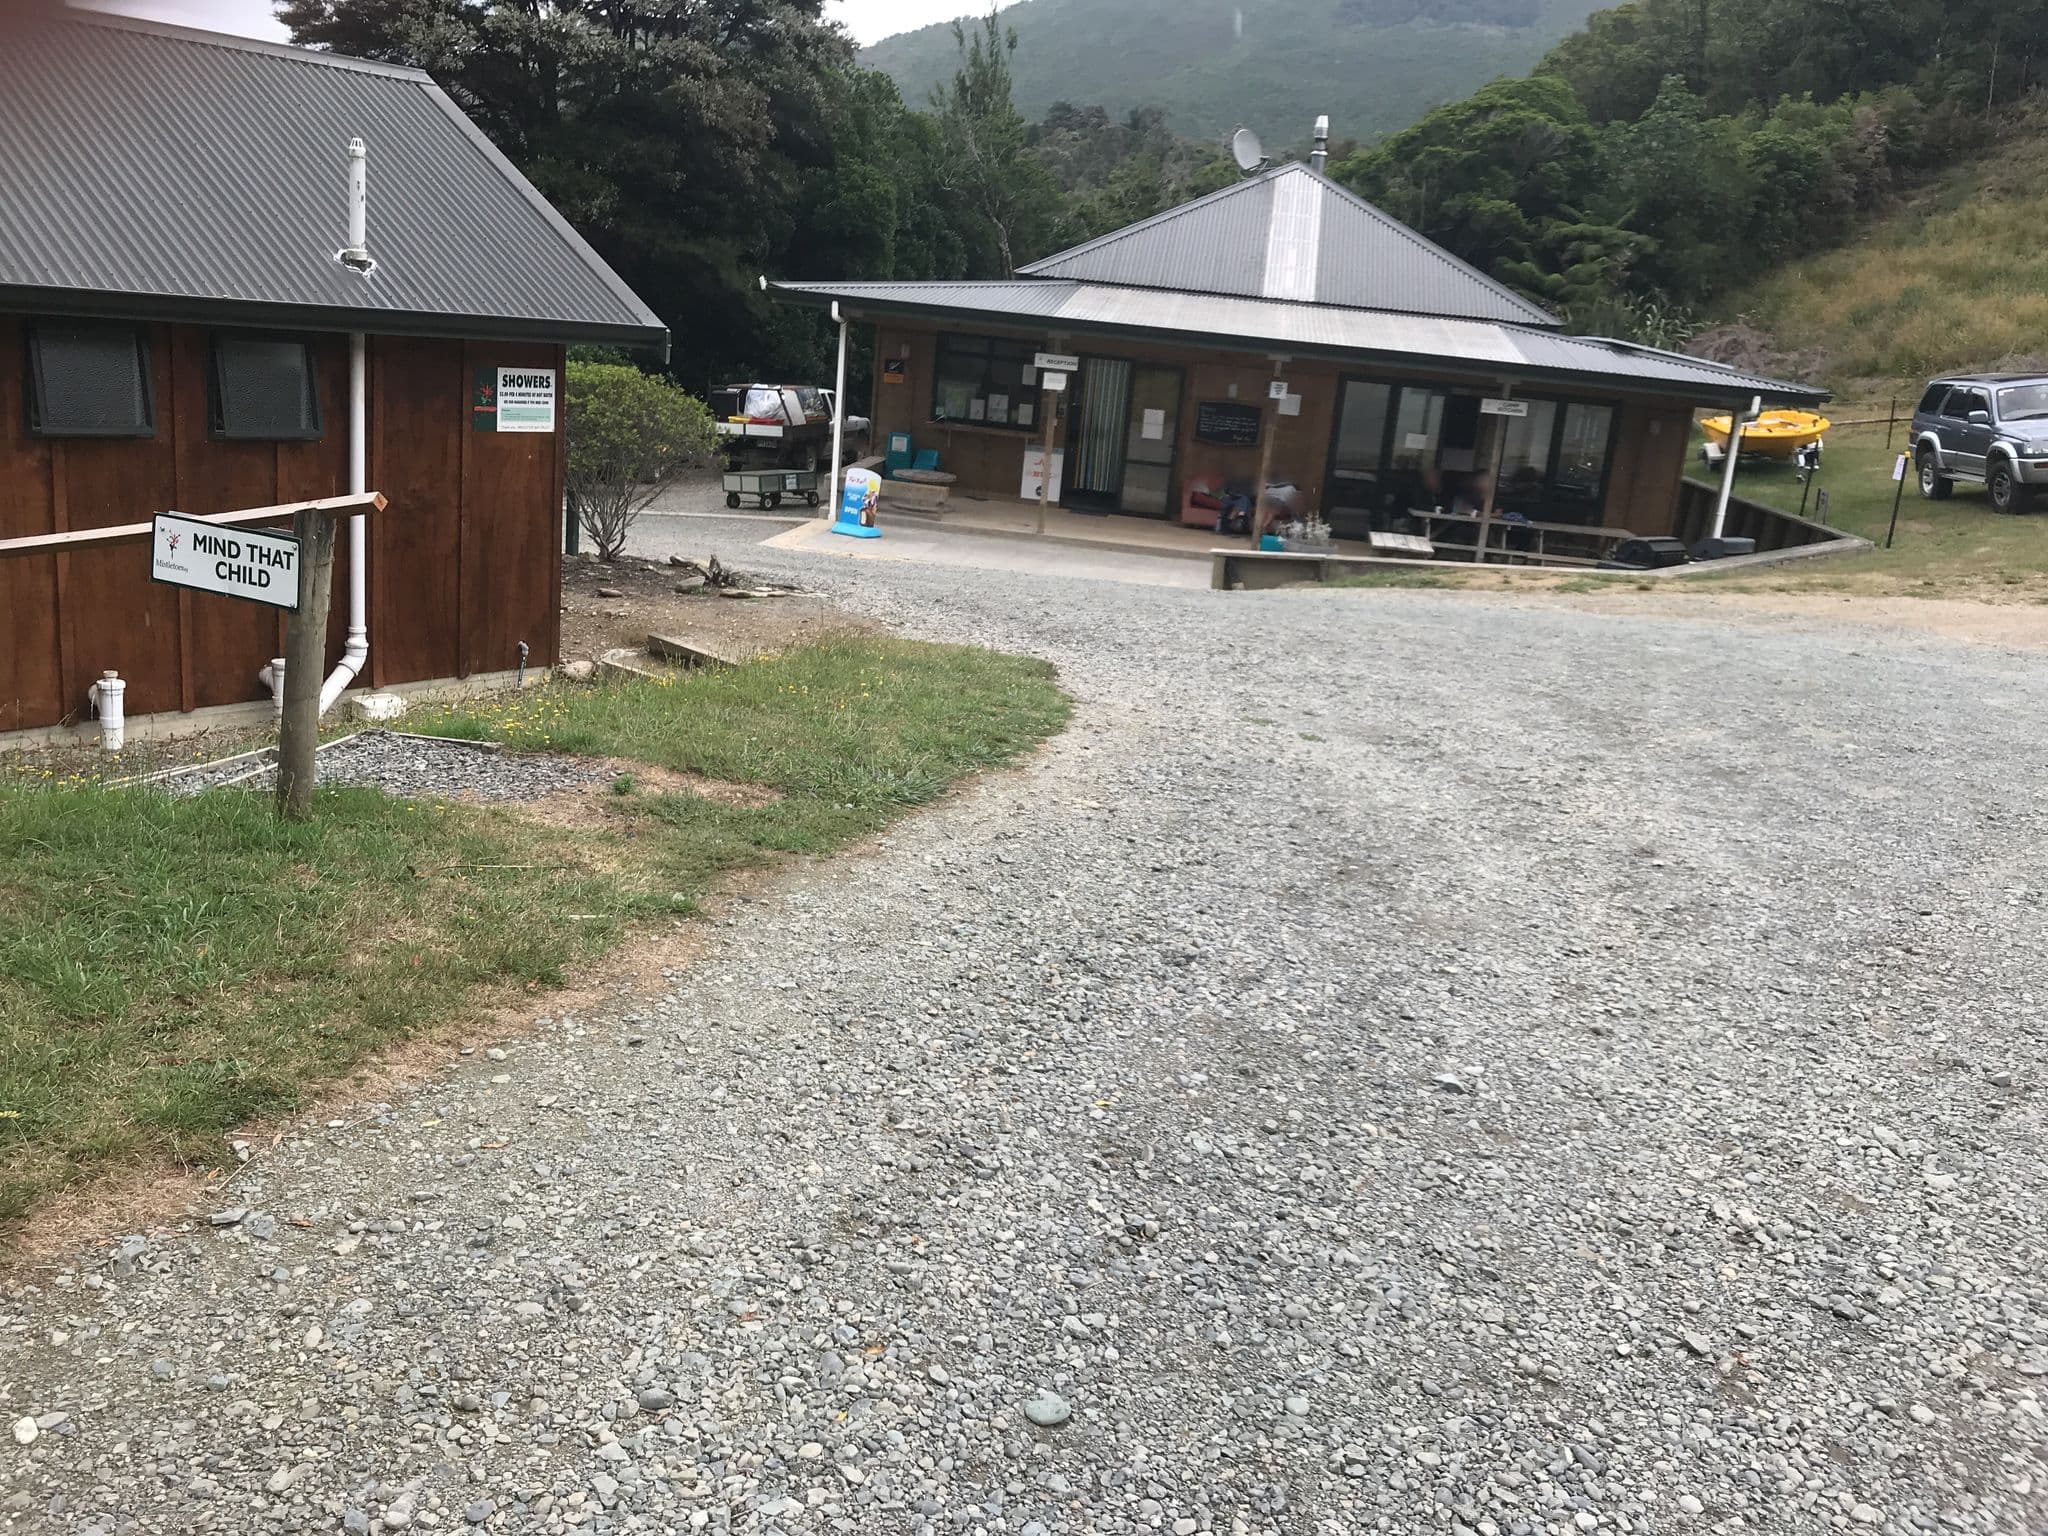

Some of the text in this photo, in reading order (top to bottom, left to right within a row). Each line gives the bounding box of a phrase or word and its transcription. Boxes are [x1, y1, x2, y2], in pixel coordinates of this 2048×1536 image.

[502, 374, 551, 388] SHOWERS
[193, 533, 294, 570] MIND THAT
[215, 561, 270, 588] CHILD
